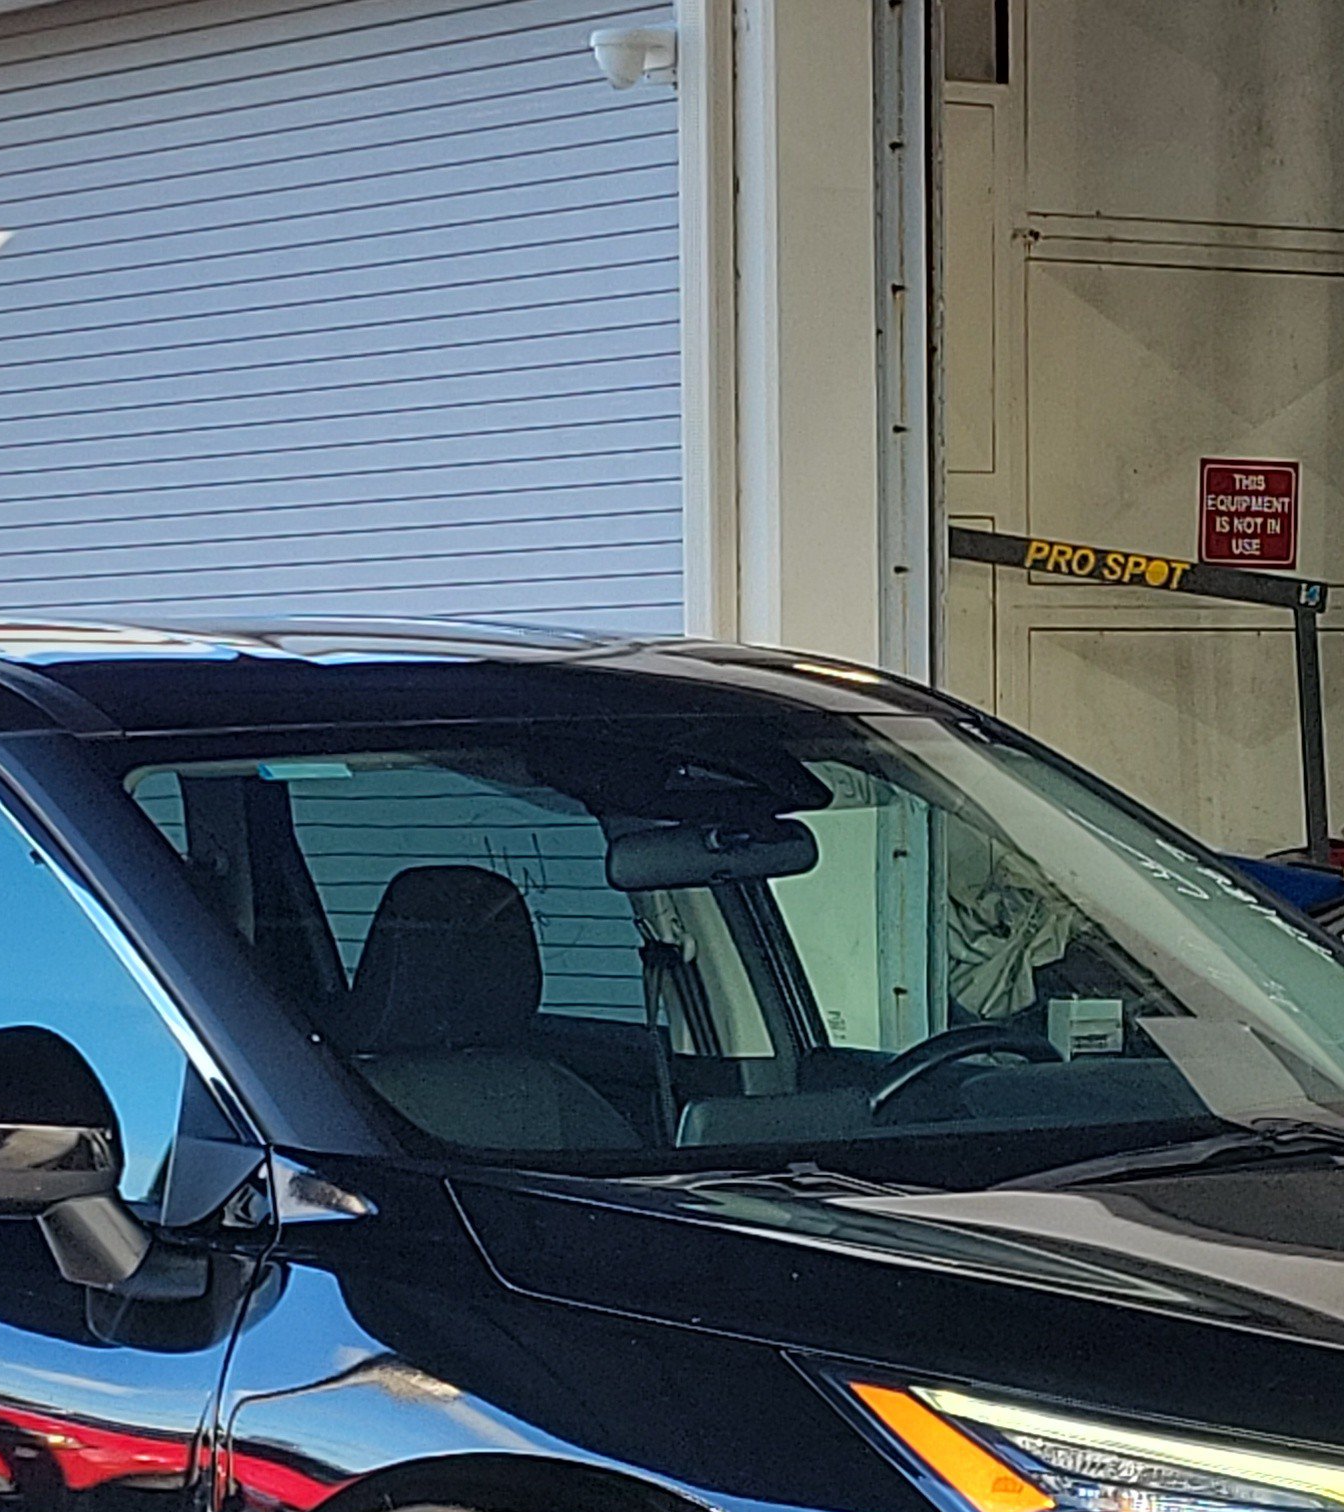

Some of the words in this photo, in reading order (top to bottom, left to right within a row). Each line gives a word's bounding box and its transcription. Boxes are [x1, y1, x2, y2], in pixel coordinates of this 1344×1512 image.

[1232, 473, 1266, 491] THIS
[1207, 494, 1291, 513] EQUIPMENT
[1215, 515, 1231, 533] IS
[1233, 516, 1264, 534] NOT
[1266, 517, 1281, 534] IN
[1231, 538, 1261, 555] USE
[1024, 540, 1096, 576] PRO
[1102, 553, 1191, 590] SPOT
